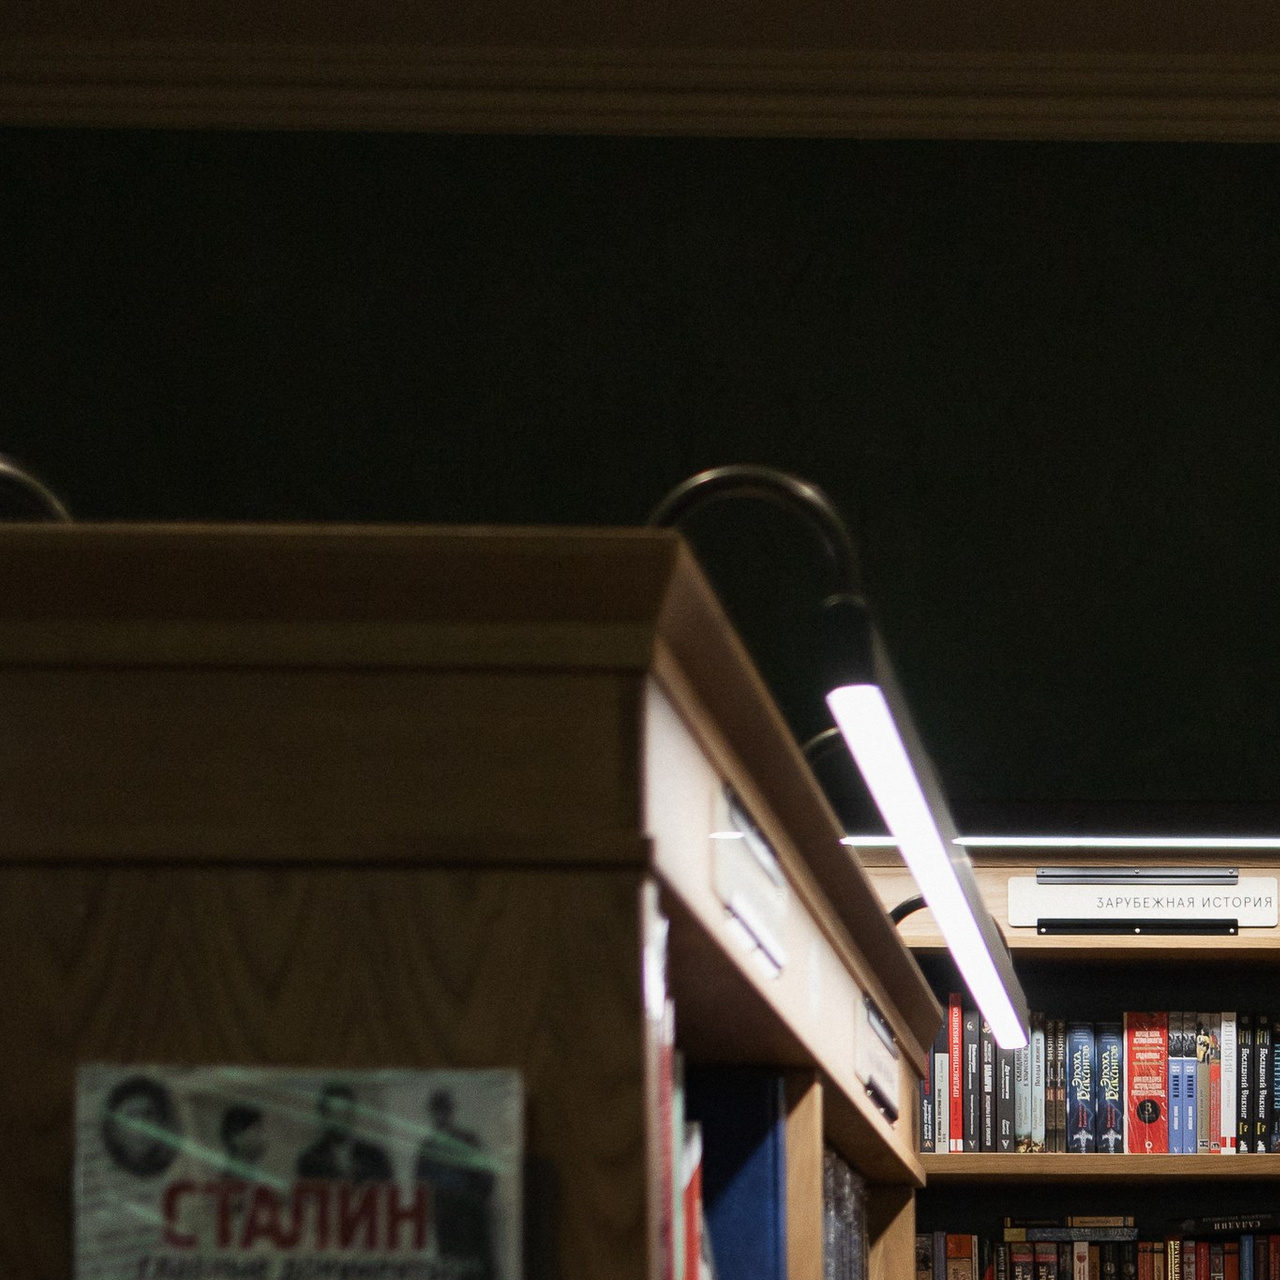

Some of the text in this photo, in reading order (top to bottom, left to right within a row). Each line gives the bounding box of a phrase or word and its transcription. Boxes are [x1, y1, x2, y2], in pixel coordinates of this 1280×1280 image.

[1096, 896, 1273, 909] ЗАРУБЕЖНАЯ ИСТОРИЯ
[163, 1180, 430, 1249] СТАЛИН
